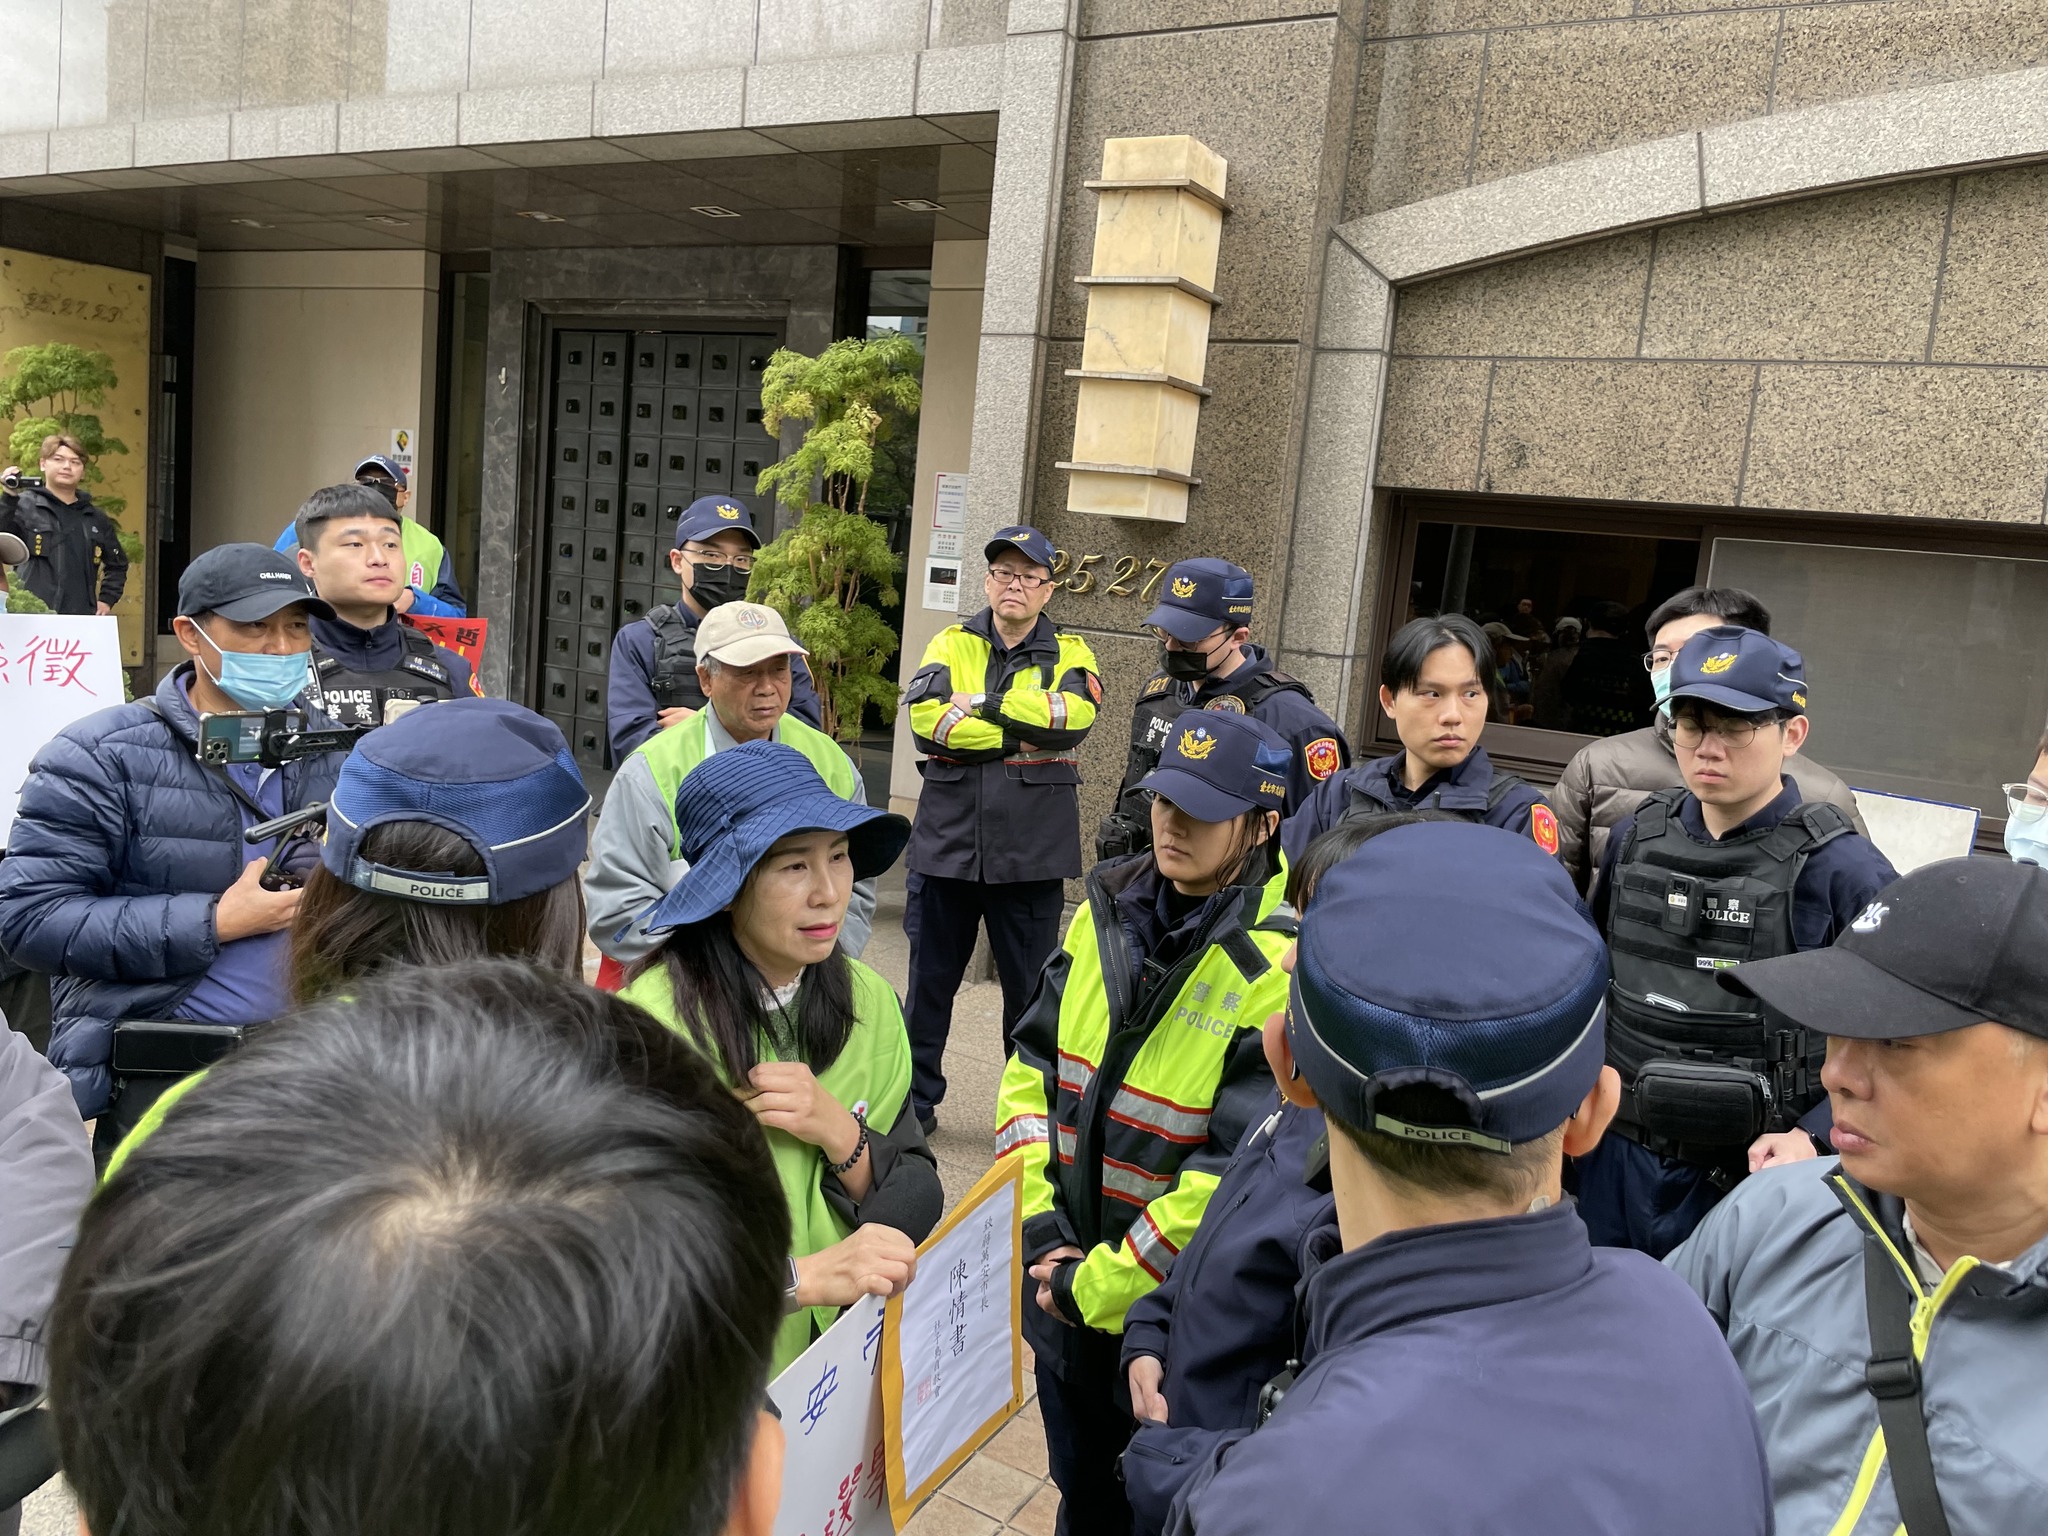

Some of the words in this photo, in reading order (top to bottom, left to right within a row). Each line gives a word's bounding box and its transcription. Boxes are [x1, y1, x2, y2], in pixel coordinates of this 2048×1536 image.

[1105, 555, 1172, 602] 27
[1145, 676, 1170, 694] 221
[327, 703, 373, 720] 警察
[1149, 716, 1173, 734] POLIC
[409, 884, 464, 898] POLICE
[1192, 981, 1243, 1014] 警察
[1174, 1006, 1235, 1039] POLICE
[1404, 1126, 1471, 1141] POLICE
[949, 1258, 969, 1357] 陳情書
